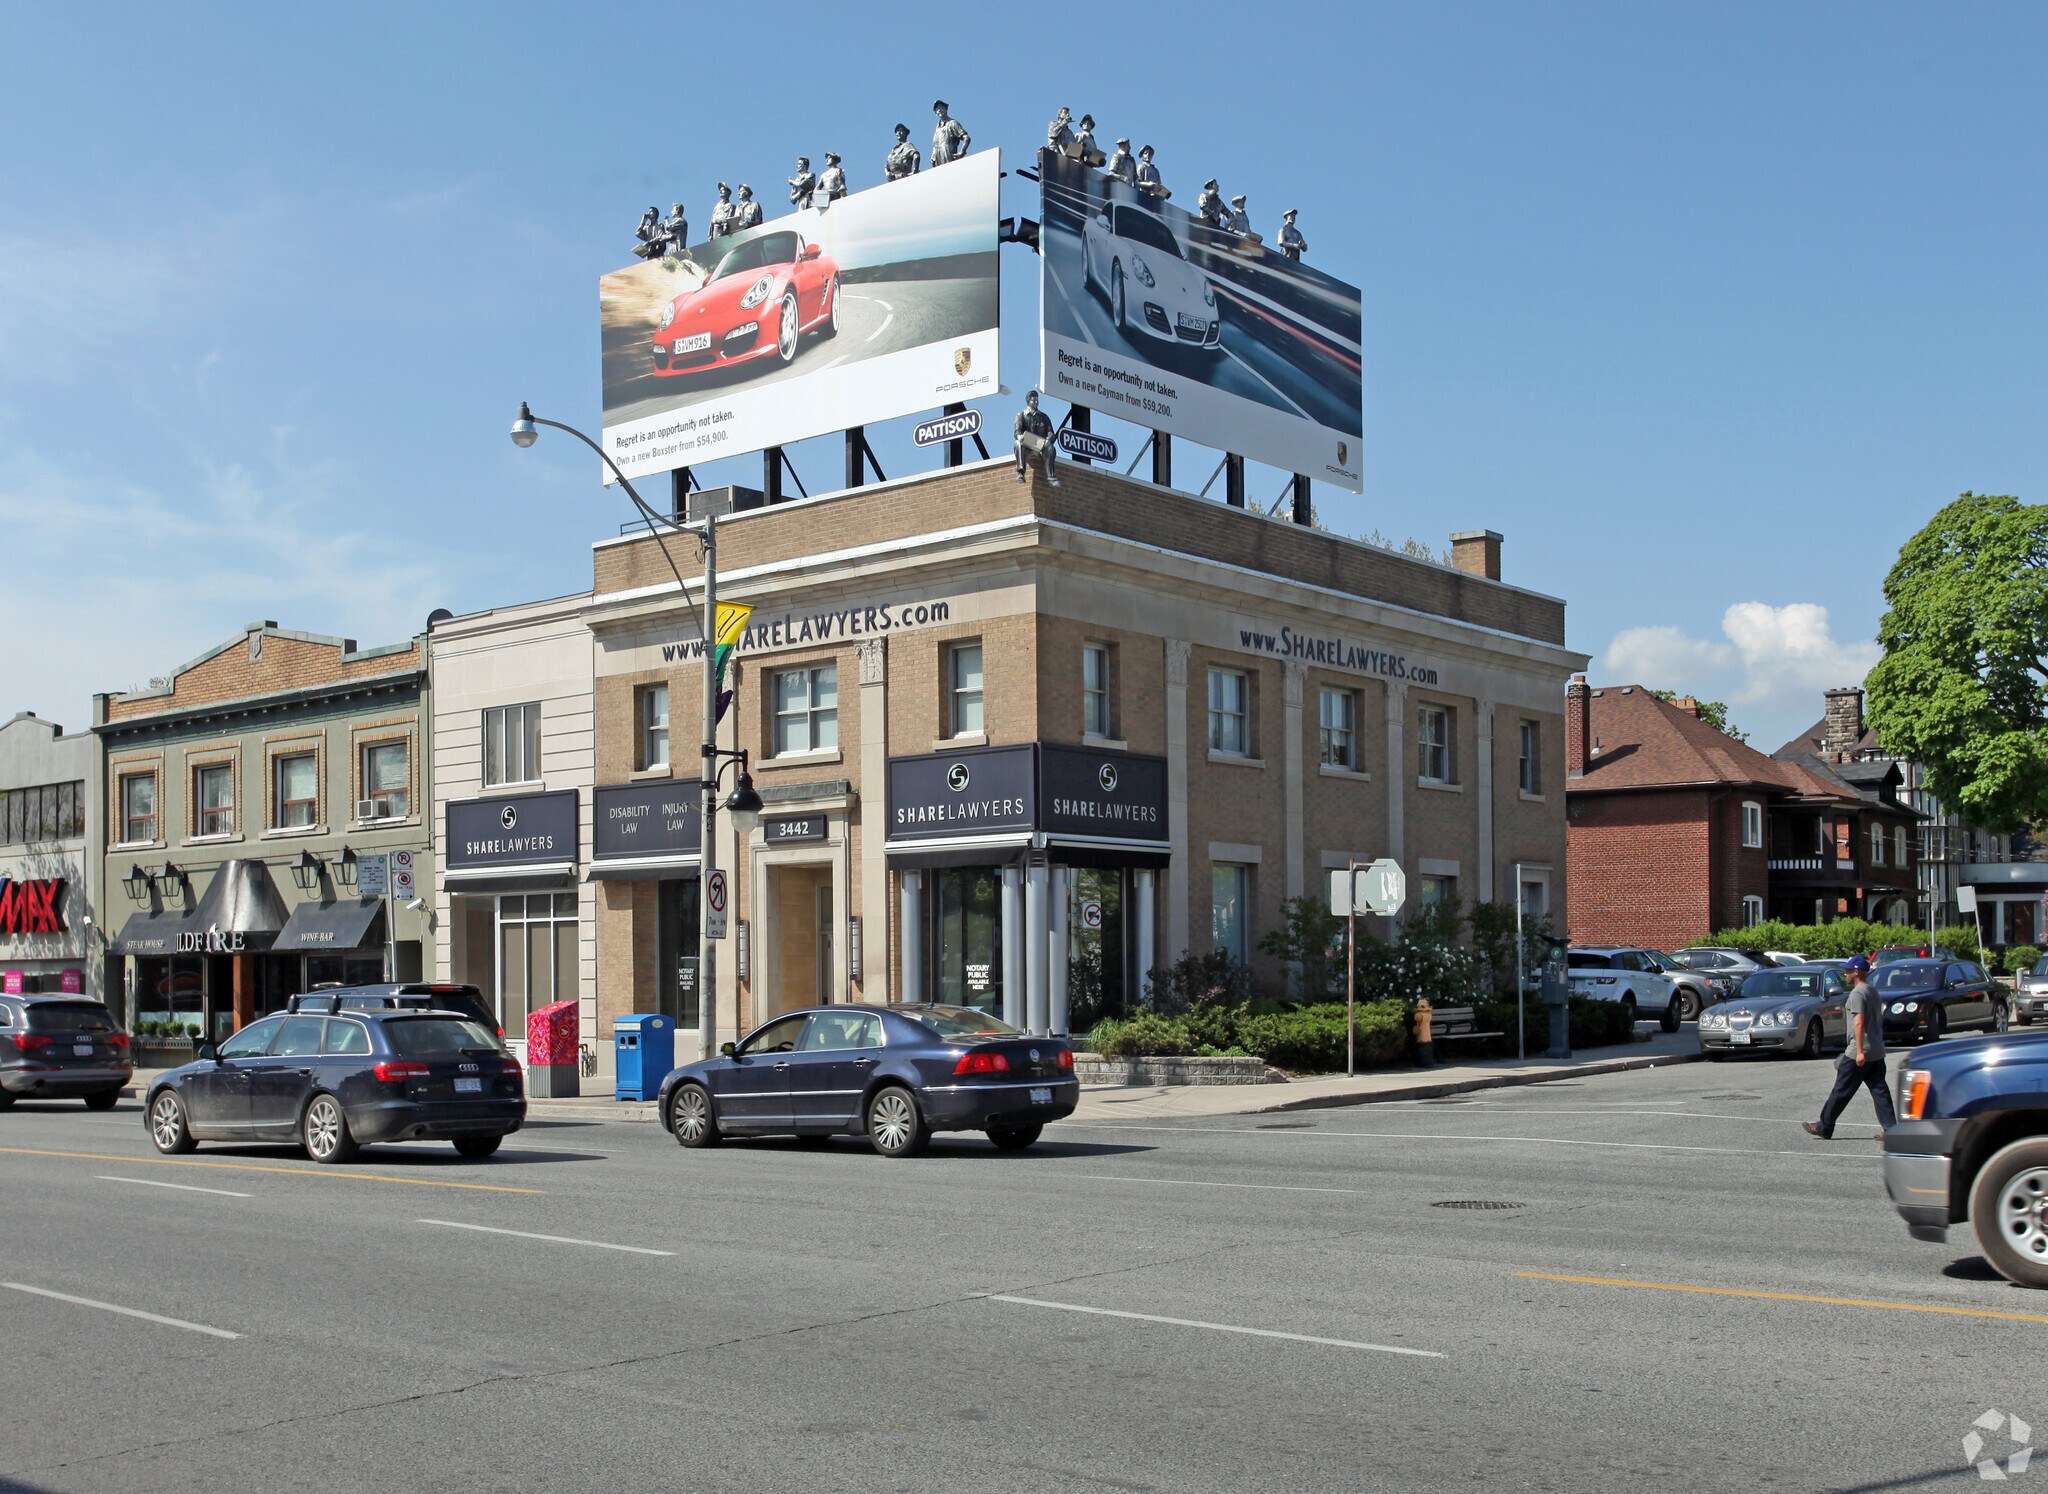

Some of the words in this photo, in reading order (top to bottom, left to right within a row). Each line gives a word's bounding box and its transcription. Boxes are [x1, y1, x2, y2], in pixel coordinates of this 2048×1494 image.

[1058, 349, 1083, 368] Regret
[1084, 357, 1091, 371] is
[1093, 363, 1101, 374] an
[1103, 367, 1143, 389] opportunity
[1144, 379, 1156, 392] not
[1157, 382, 1178, 399] taken.
[936, 376, 990, 393] PORSCHE
[1058, 371, 1074, 386] Own
[1075, 380, 1080, 389] a
[1082, 380, 1096, 393] new
[1098, 383, 1124, 402] Cayman
[1125, 392, 1141, 407] from
[1142, 398, 1173, 418] $59,200.
[616, 435, 638, 449] Regret
[639, 431, 646, 442] is
[647, 430, 656, 440] an
[657, 419, 698, 439] opportunity
[698, 415, 711, 427] not
[712, 411, 735, 424] taken.
[918, 415, 976, 442] PATTISON
[616, 456, 630, 467] Own
[631, 455, 636, 463] a
[637, 451, 651, 461] new
[652, 444, 677, 458] Boxster
[679, 441, 695, 452] from
[696, 430, 729, 447] $54,900.
[1063, 432, 1114, 458] PATTISON
[609, 805, 650, 819] DISABILITY
[662, 802, 689, 816] INJURY
[621, 822, 638, 834] LAW
[667, 819, 685, 831] LAW
[779, 821, 809, 836] 3442
[0, 878, 59, 933] MAX
[126, 940, 145, 950] STEAK
[145, 939, 165, 949] HOUSE
[176, 930, 246, 953] ILDFIRE
[300, 932, 318, 942] WINE
[318, 931, 334, 942] BAR
